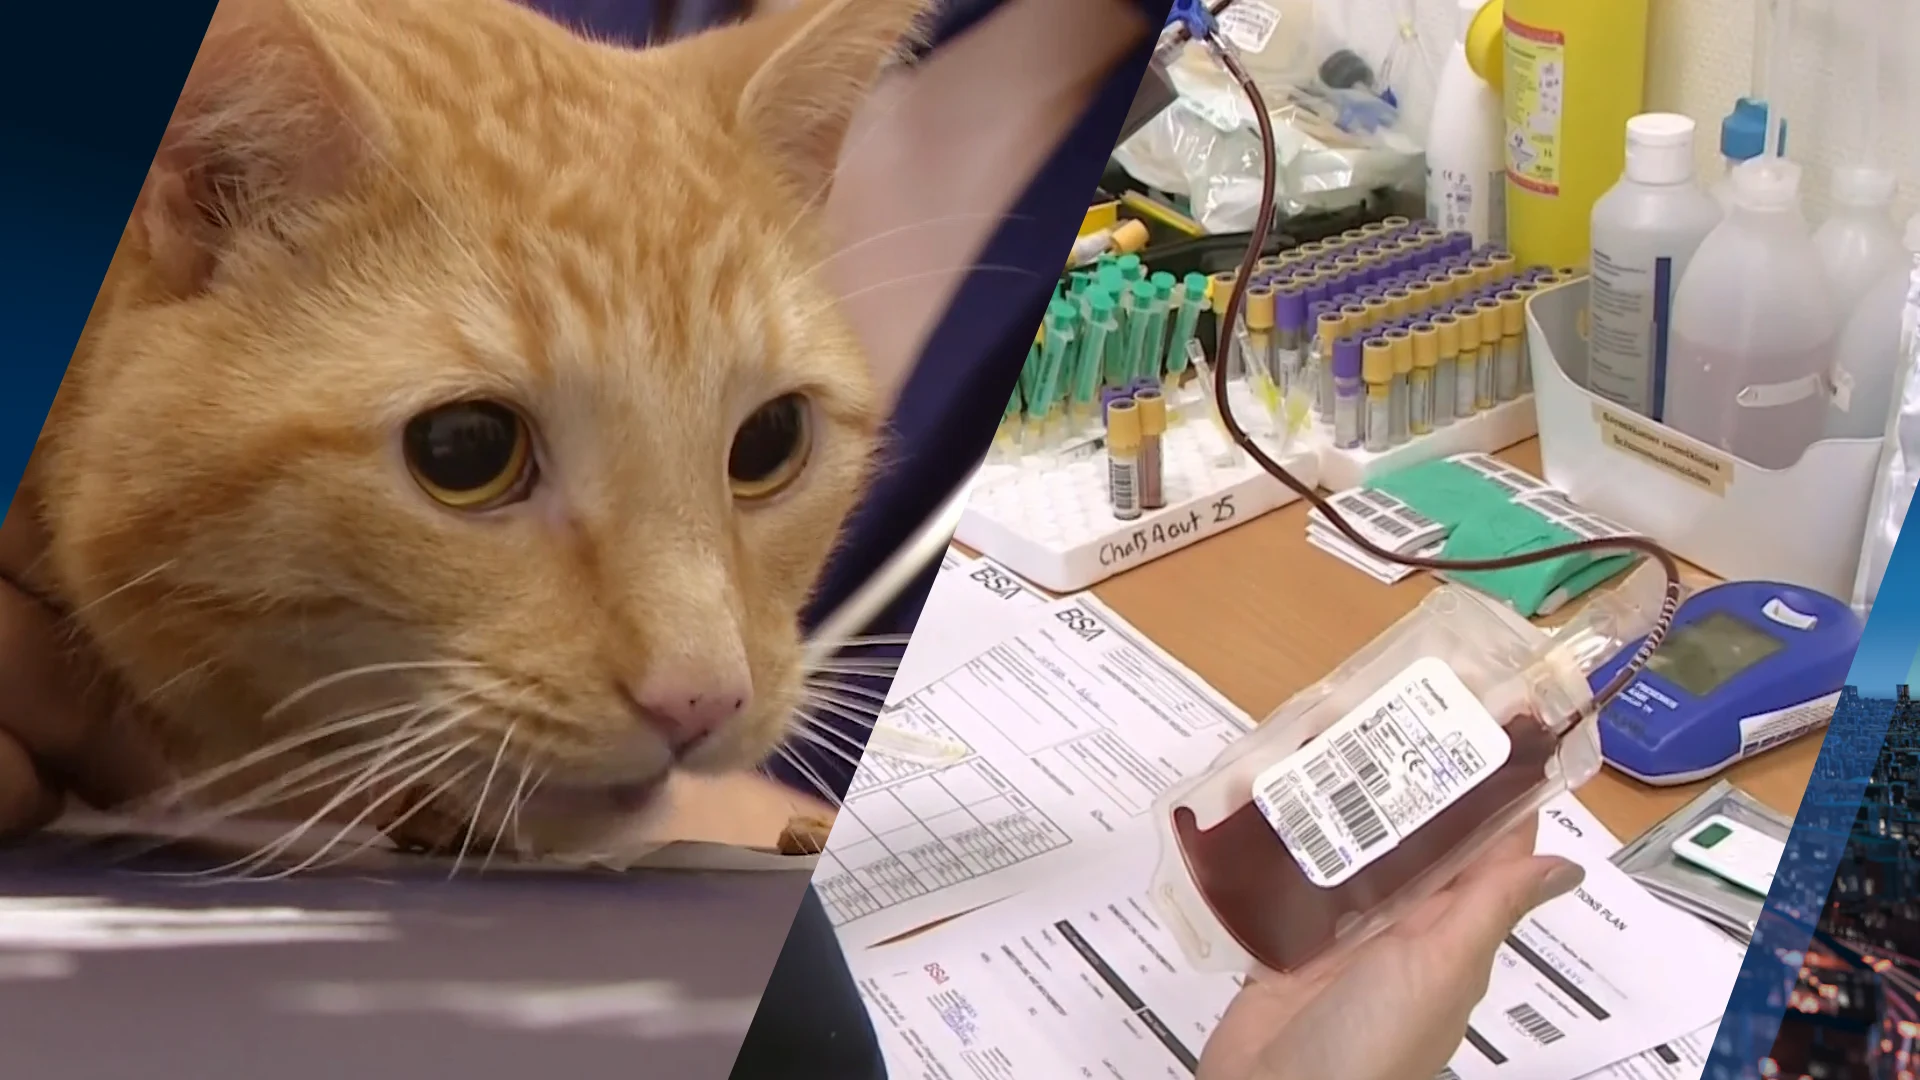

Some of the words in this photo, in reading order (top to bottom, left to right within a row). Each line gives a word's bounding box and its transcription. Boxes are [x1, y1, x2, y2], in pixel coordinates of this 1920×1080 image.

[1211, 494, 1236, 523] 25
[968, 564, 1021, 600] BSA
[1055, 607, 1106, 642] BSA
